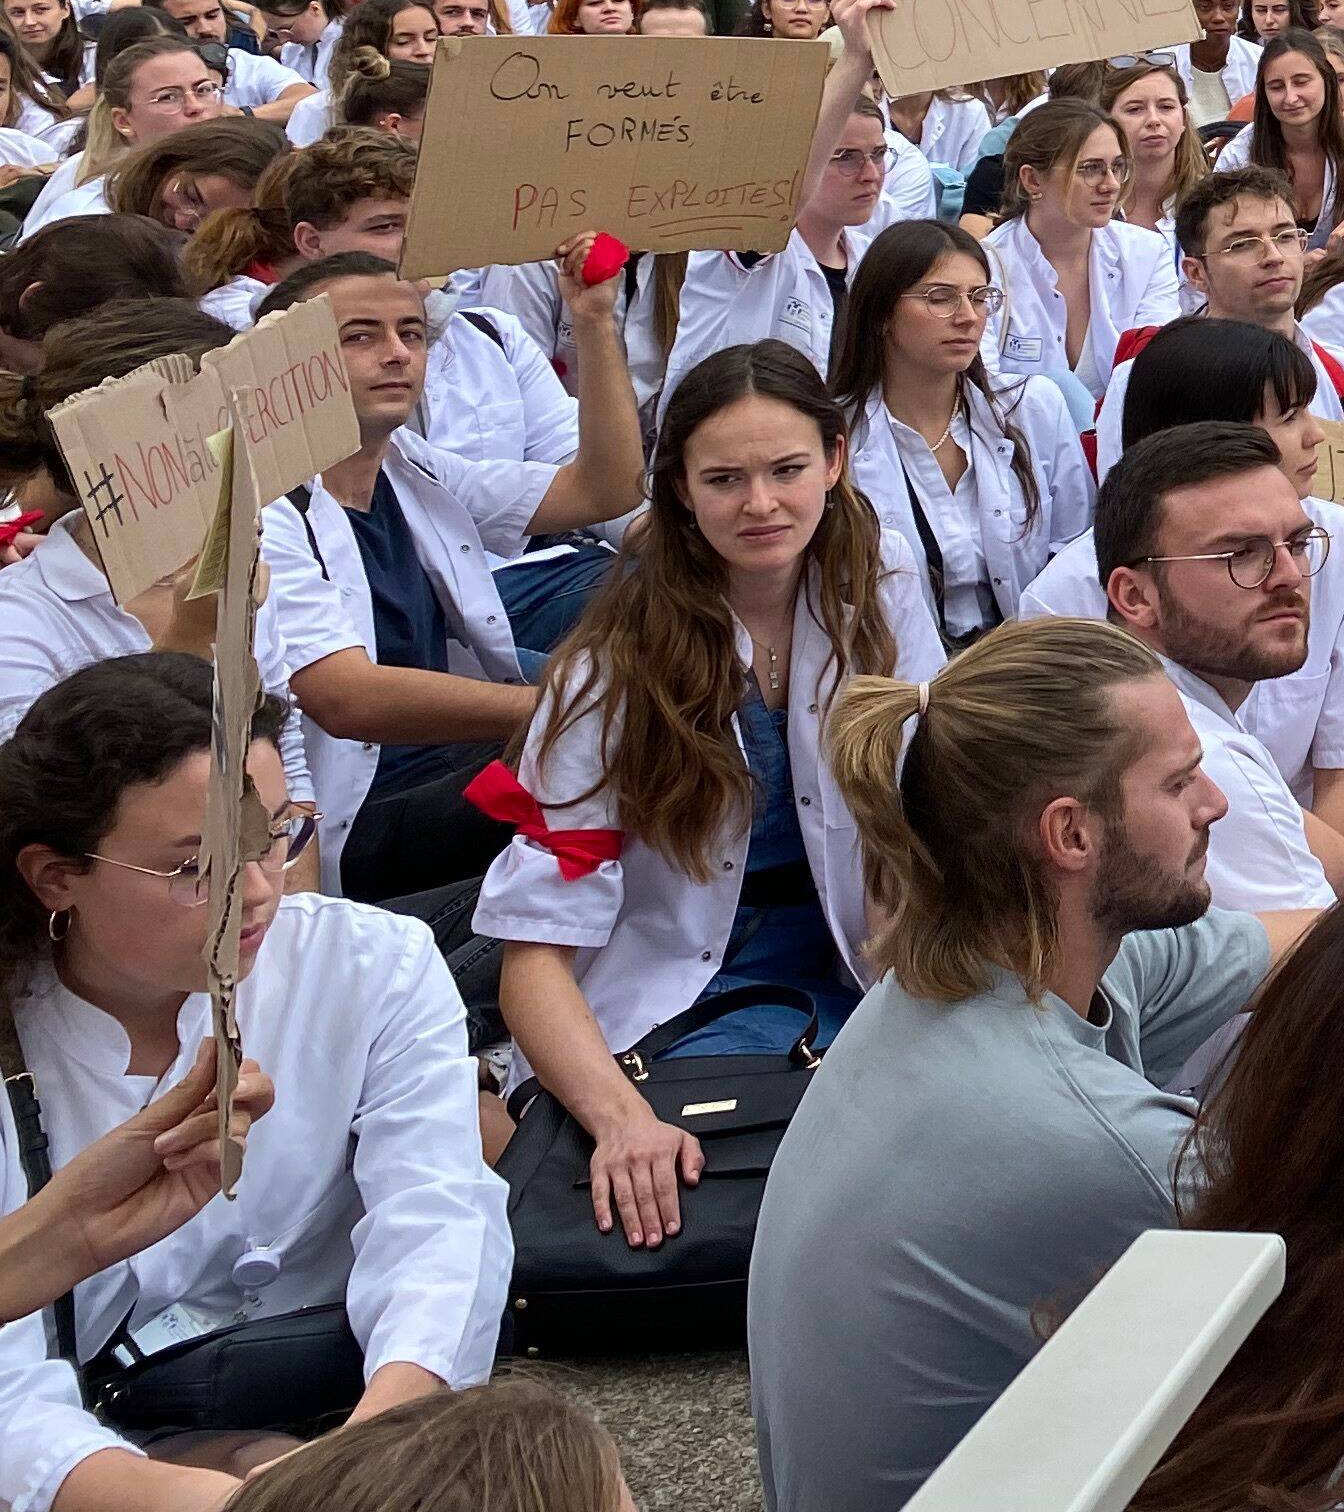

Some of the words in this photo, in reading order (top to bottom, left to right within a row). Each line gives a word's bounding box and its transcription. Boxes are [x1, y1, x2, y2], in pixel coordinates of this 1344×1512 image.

[490, 52, 569, 100] On
[710, 76, 764, 103] être
[512, 183, 586, 231] PAS
